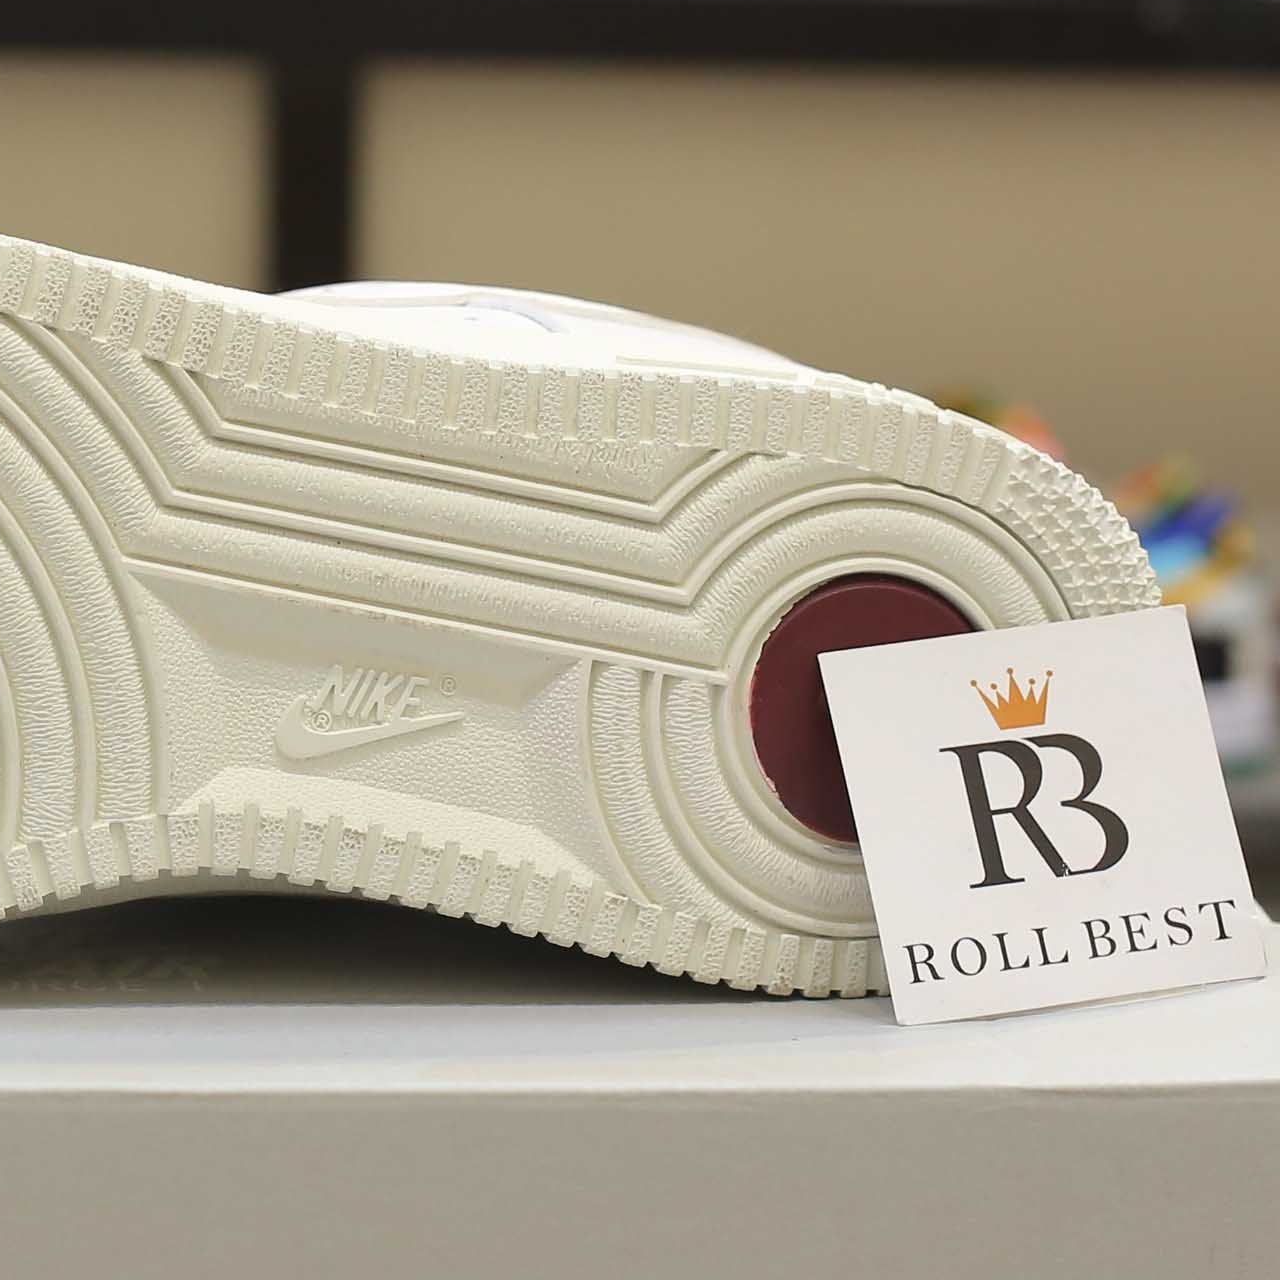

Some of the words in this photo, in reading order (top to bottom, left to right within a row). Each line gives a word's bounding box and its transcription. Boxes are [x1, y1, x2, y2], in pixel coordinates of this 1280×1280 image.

[311, 665, 430, 722] NIKE
[903, 926, 1070, 985] ROLL
[1081, 899, 1236, 961] BEST
